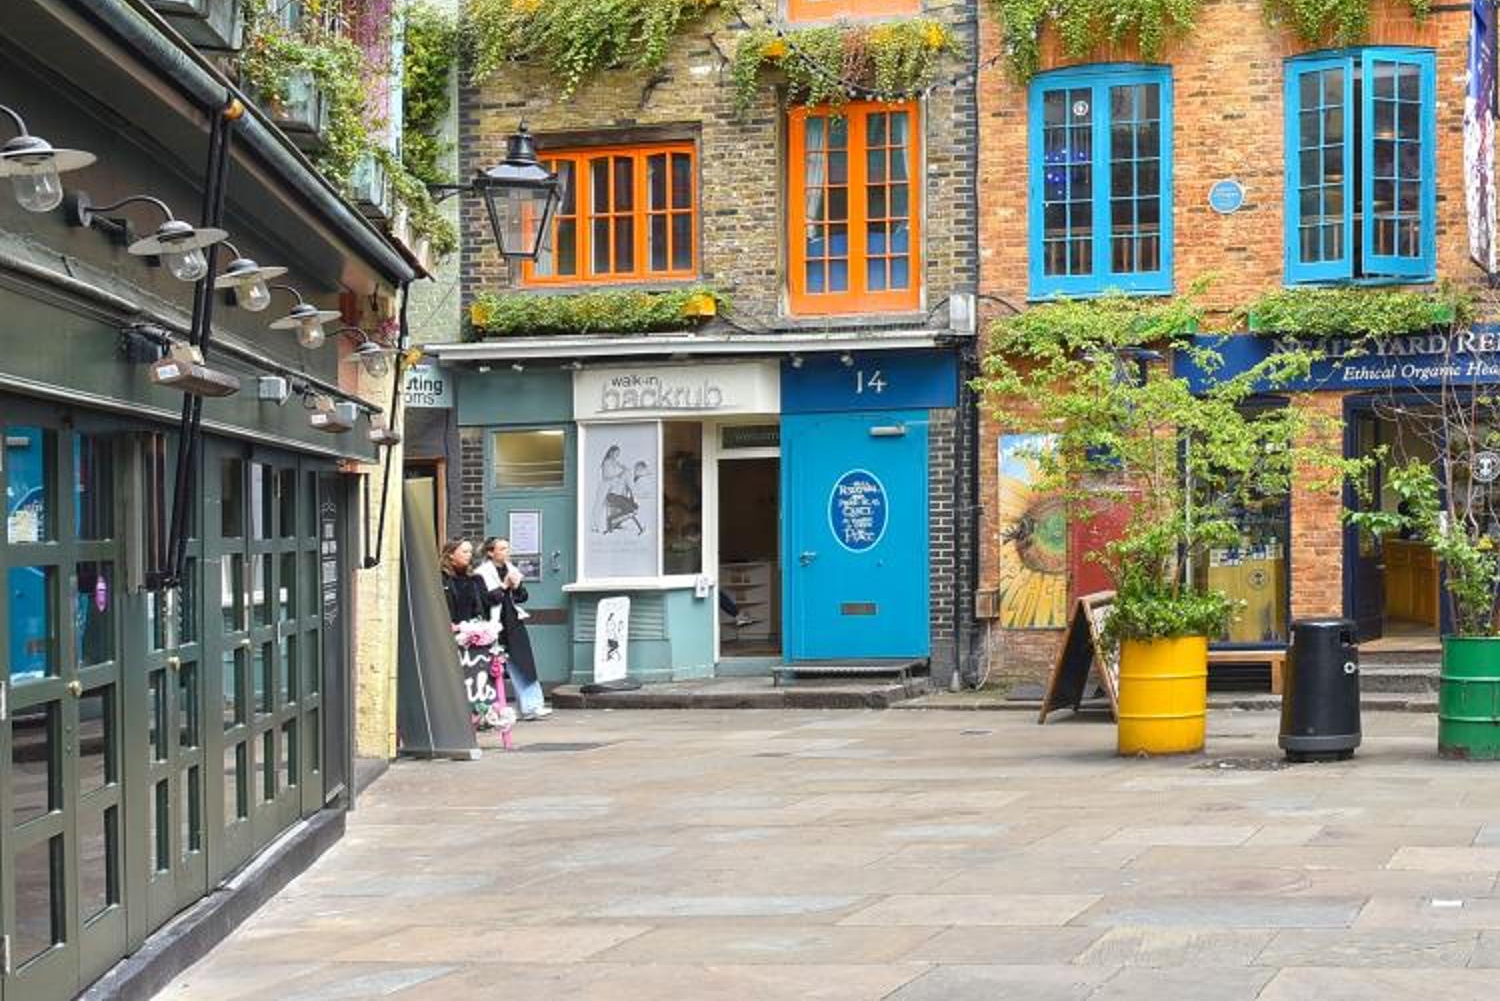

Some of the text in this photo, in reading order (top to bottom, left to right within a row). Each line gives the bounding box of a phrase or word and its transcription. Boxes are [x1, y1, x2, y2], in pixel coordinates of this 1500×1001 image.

[1376, 334, 1447, 357] YARD
[611, 374, 659, 388] walk-in
[856, 370, 888, 394] 14
[1343, 365, 1397, 381] Ethical
[1401, 363, 1461, 381] Organic
[601, 379, 723, 410] backrub
